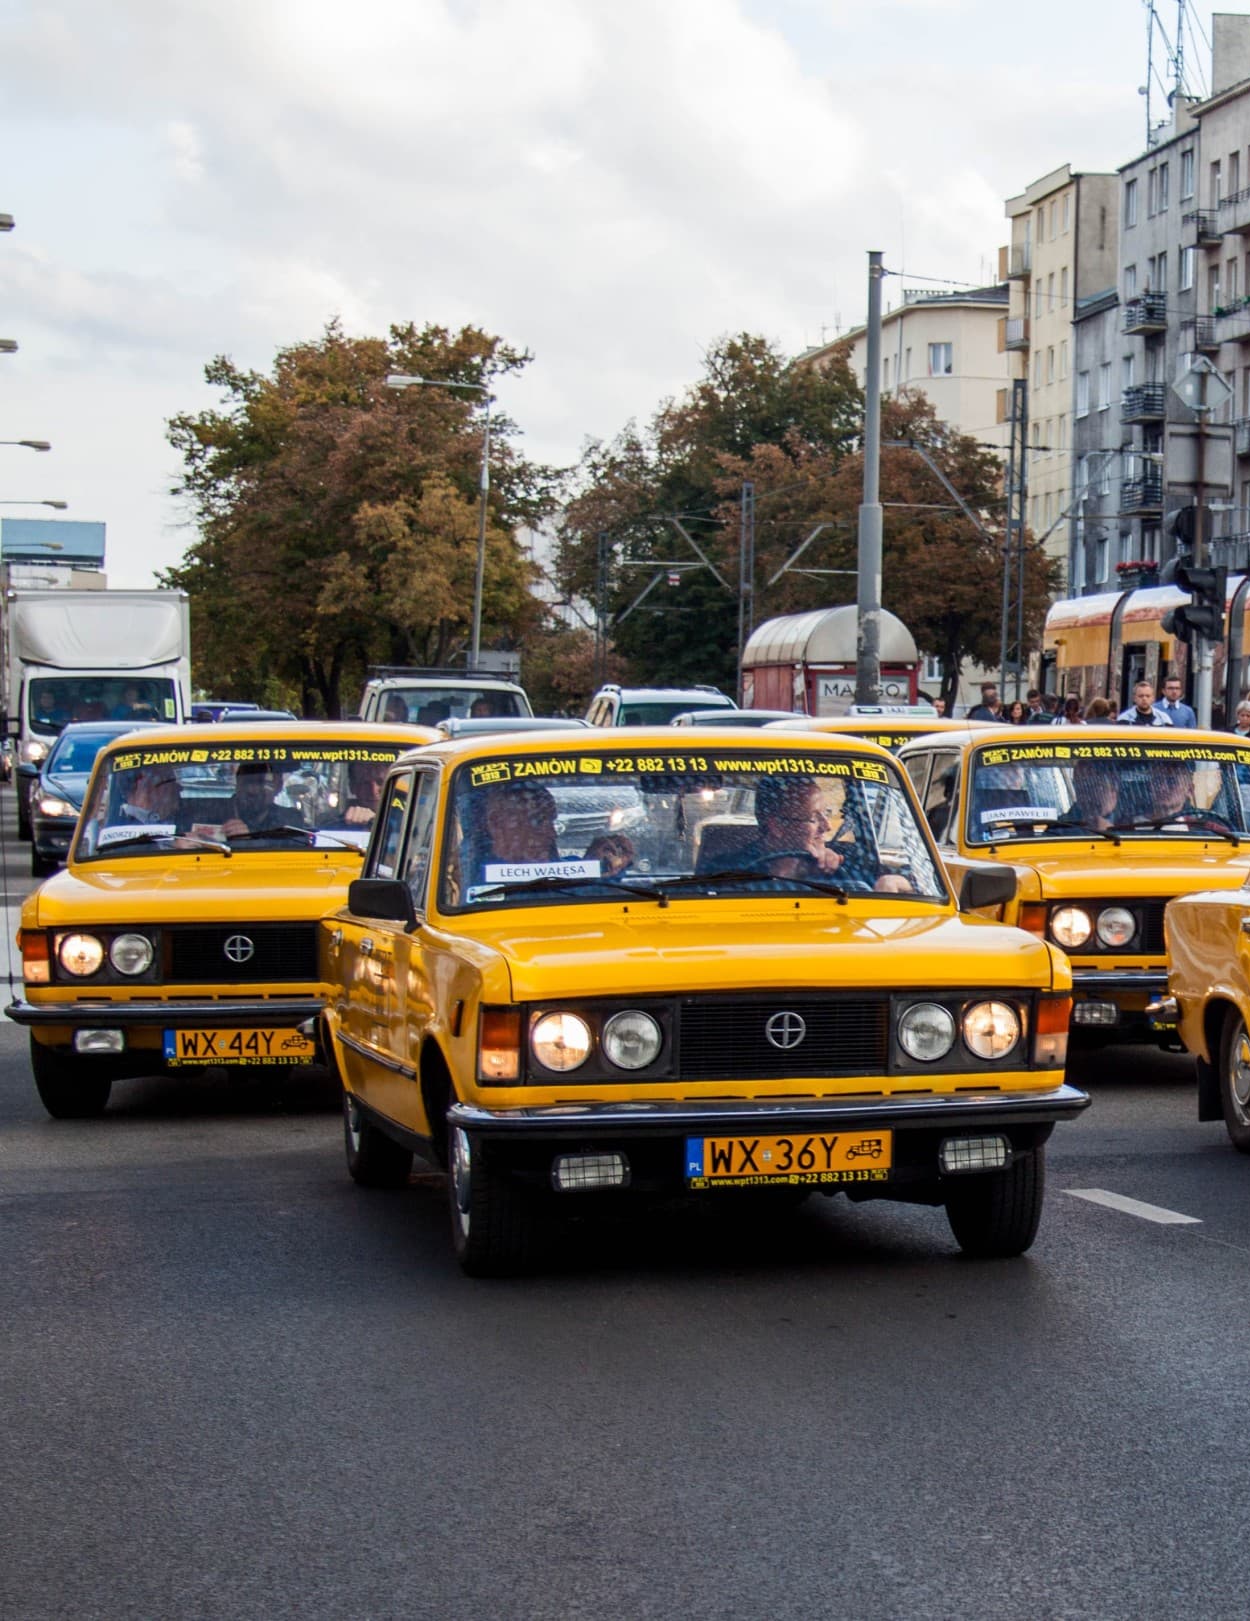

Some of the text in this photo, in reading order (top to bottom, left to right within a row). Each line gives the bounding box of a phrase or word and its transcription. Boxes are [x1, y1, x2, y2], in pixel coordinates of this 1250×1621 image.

[824, 683, 900, 697] MAGO
[144, 750, 190, 765] ZAMÓW
[211, 751, 231, 761] +22
[234, 750, 254, 760] 882
[257, 750, 270, 760] 13
[273, 749, 286, 760] 13
[292, 749, 396, 763] www.wpt1313.com
[1011, 746, 1054, 760] ZAMÓW
[1073, 748, 1092, 758] +22
[1093, 748, 1111, 758] 882
[1114, 748, 1126, 758] 13
[1129, 748, 1141, 758] 13
[1145, 748, 1237, 762] www.wpt1313.com
[514, 758, 850, 777] ZAMÓW +22 882 13 13 www.wpt1313.com
[500, 864, 586, 878] LECH WAŁĘSA
[182, 1031, 275, 1055] WX 44Y
[279, 1057, 288, 1065] 13
[710, 1136, 838, 1174] WX 36Y
[689, 1163, 701, 1171] PL
[710, 1176, 788, 1187] www.wpt1313.com
[799, 1174, 818, 1183] +22
[820, 1173, 839, 1183] 882
[842, 1172, 854, 1182] 13
[857, 1171, 869, 1181] 13
